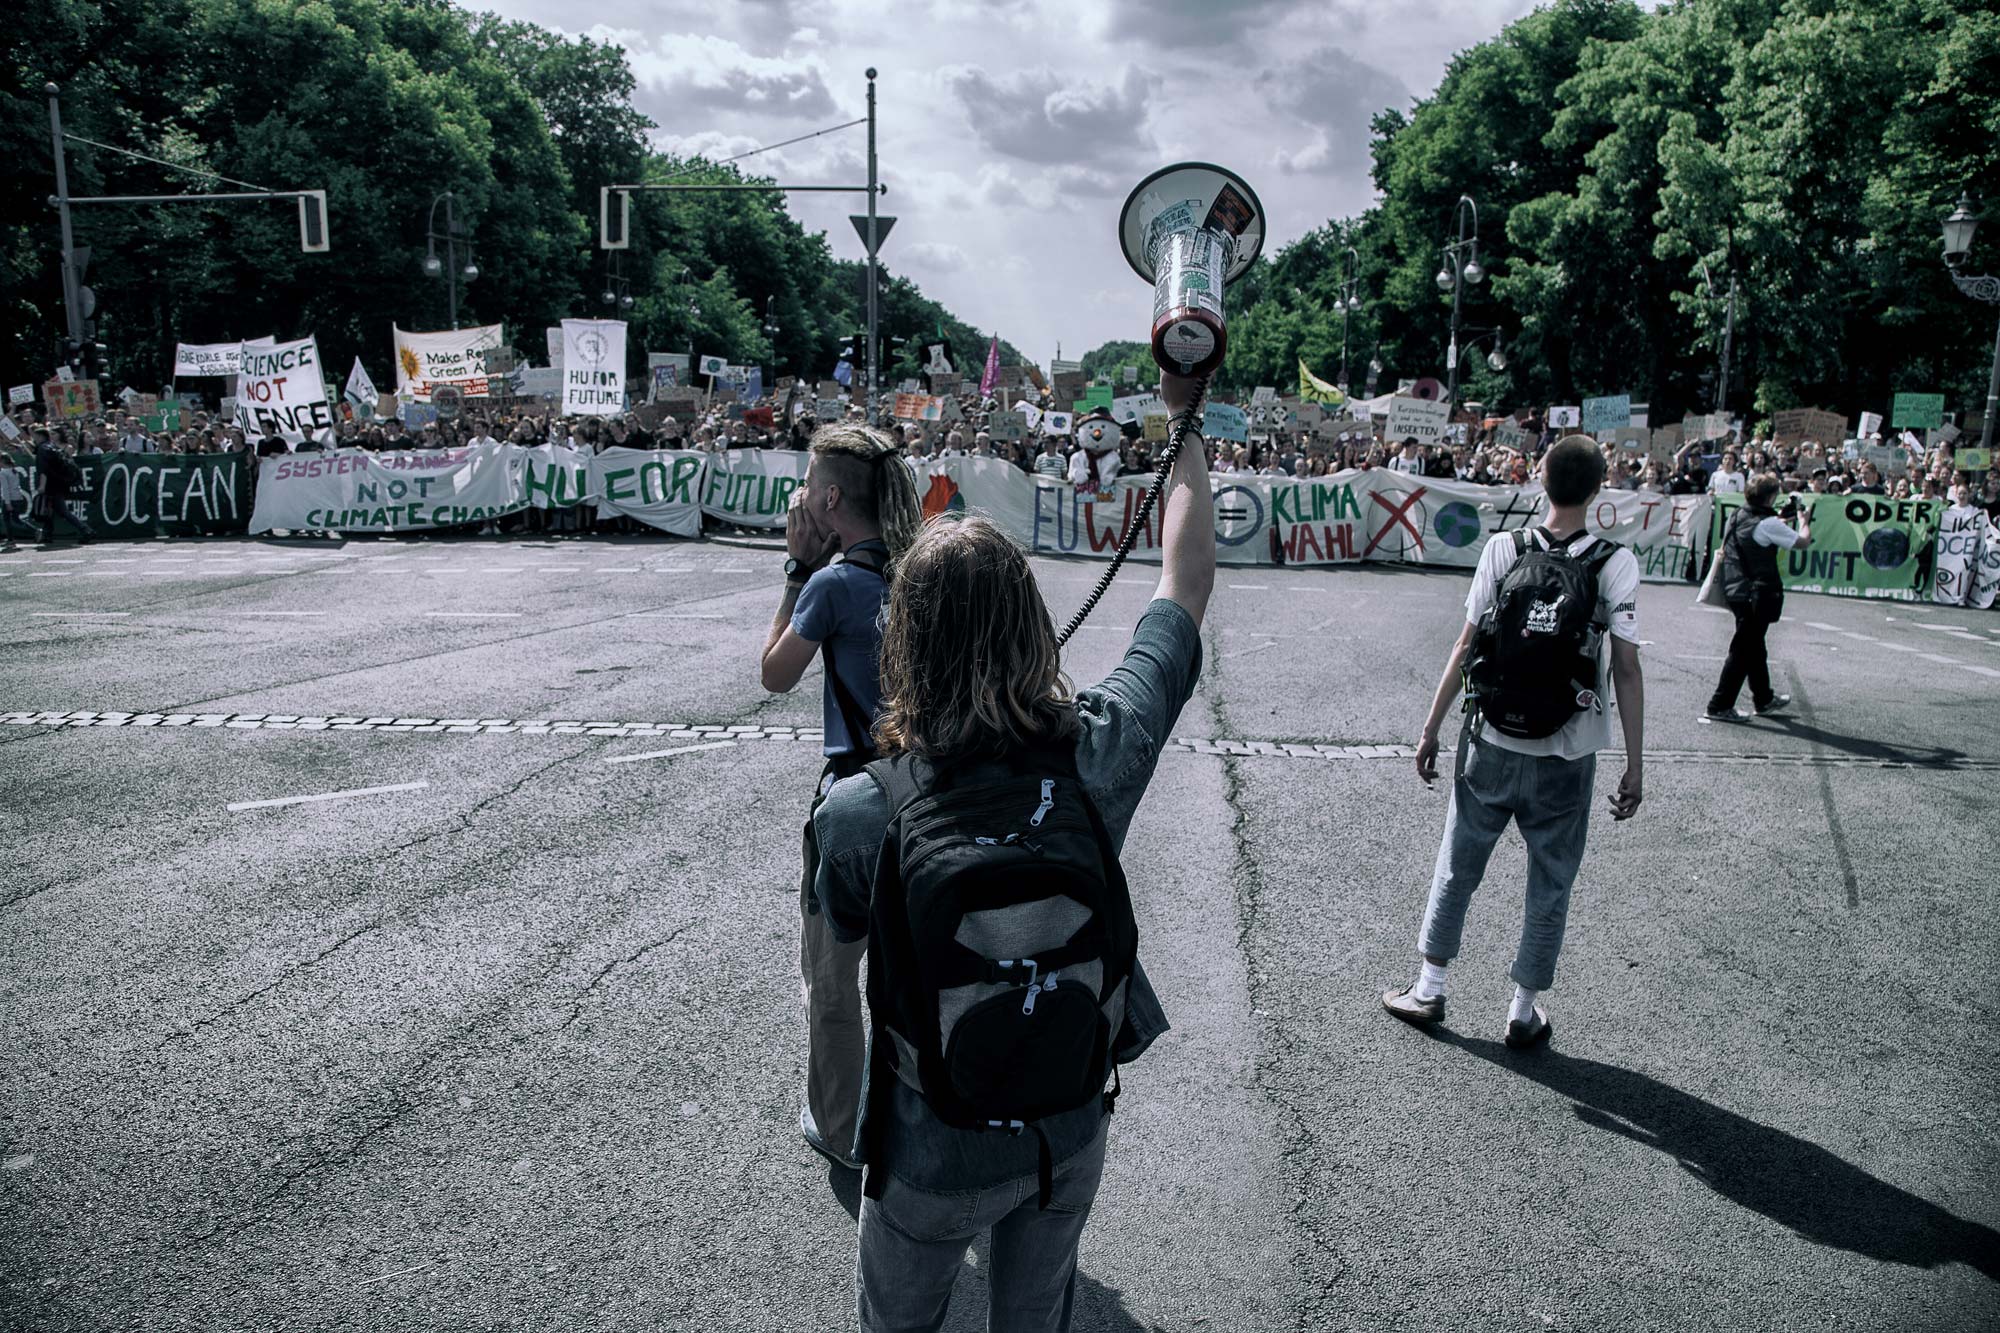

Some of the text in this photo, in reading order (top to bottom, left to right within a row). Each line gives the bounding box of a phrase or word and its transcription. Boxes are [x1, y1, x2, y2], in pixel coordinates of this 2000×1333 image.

[240, 345, 313, 376] SCIENCE
[426, 352, 460, 365] Make
[429, 366, 467, 378] Green
[570, 370, 588, 384] HU
[593, 371, 618, 386] FOR
[246, 377, 287, 402] NOT
[569, 389, 622, 405] FUTURE
[235, 401, 333, 436] SILENCE
[1393, 423, 1439, 436] INSEKTEN
[275, 449, 469, 480] SYSTEM CHANGE
[102, 463, 238, 525] OCEAN
[358, 477, 435, 503] NOT
[526, 457, 803, 516] HU FOR FUTUR
[306, 503, 425, 528] CLIMATE
[1271, 484, 1361, 523] KLIMA
[1845, 500, 1933, 524] ODER
[1034, 486, 1079, 551] EU
[1938, 510, 1984, 534] LIKE
[1269, 524, 1361, 561] WAHL
